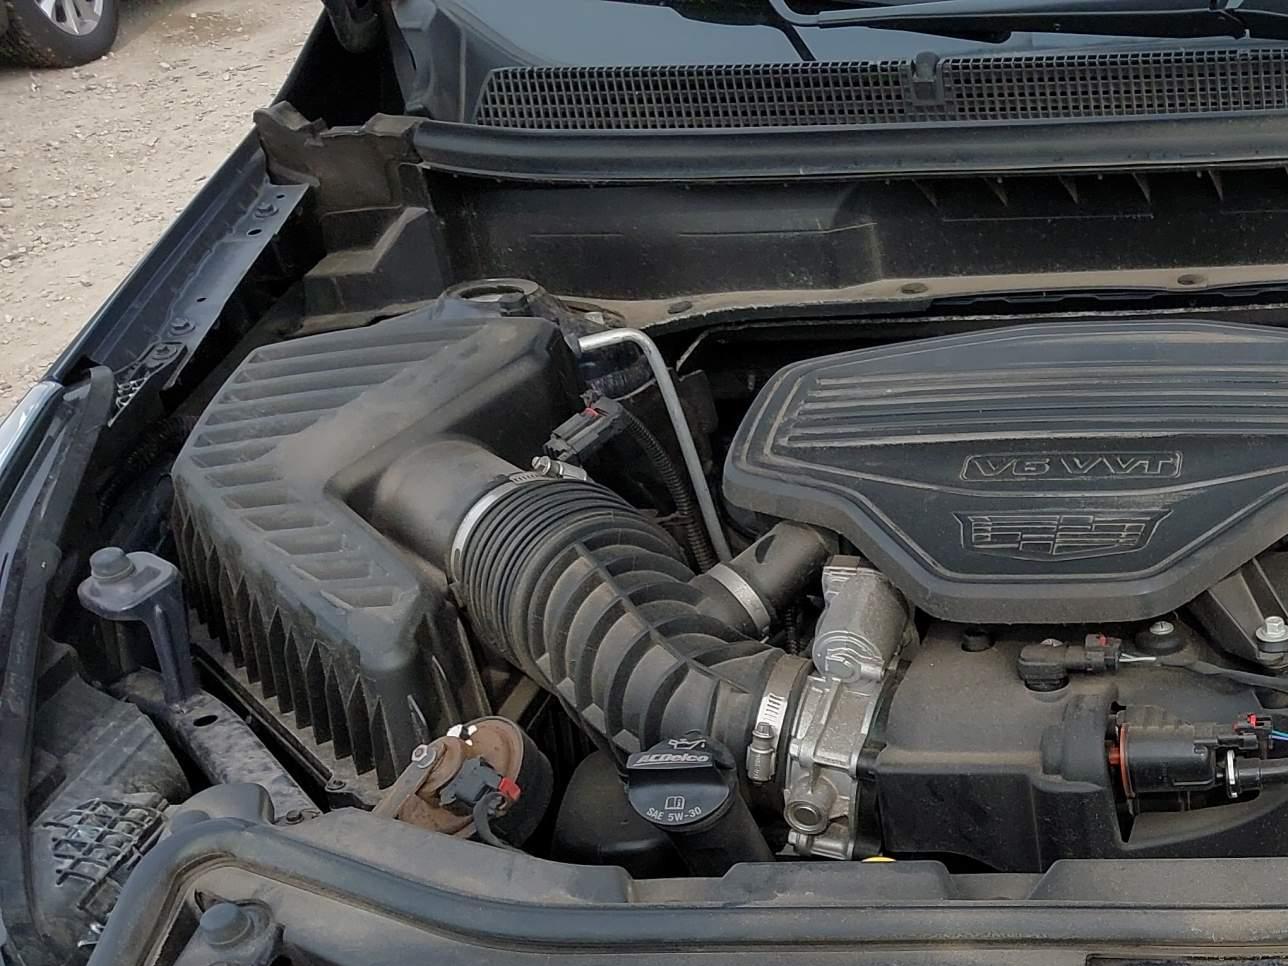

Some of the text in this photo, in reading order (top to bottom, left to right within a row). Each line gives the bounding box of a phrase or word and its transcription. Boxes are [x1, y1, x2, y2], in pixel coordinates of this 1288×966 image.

[973, 456, 1174, 476] V6 VVT
[633, 753, 709, 765] ACDelco
[646, 806, 702, 822] SAE 5W-30
